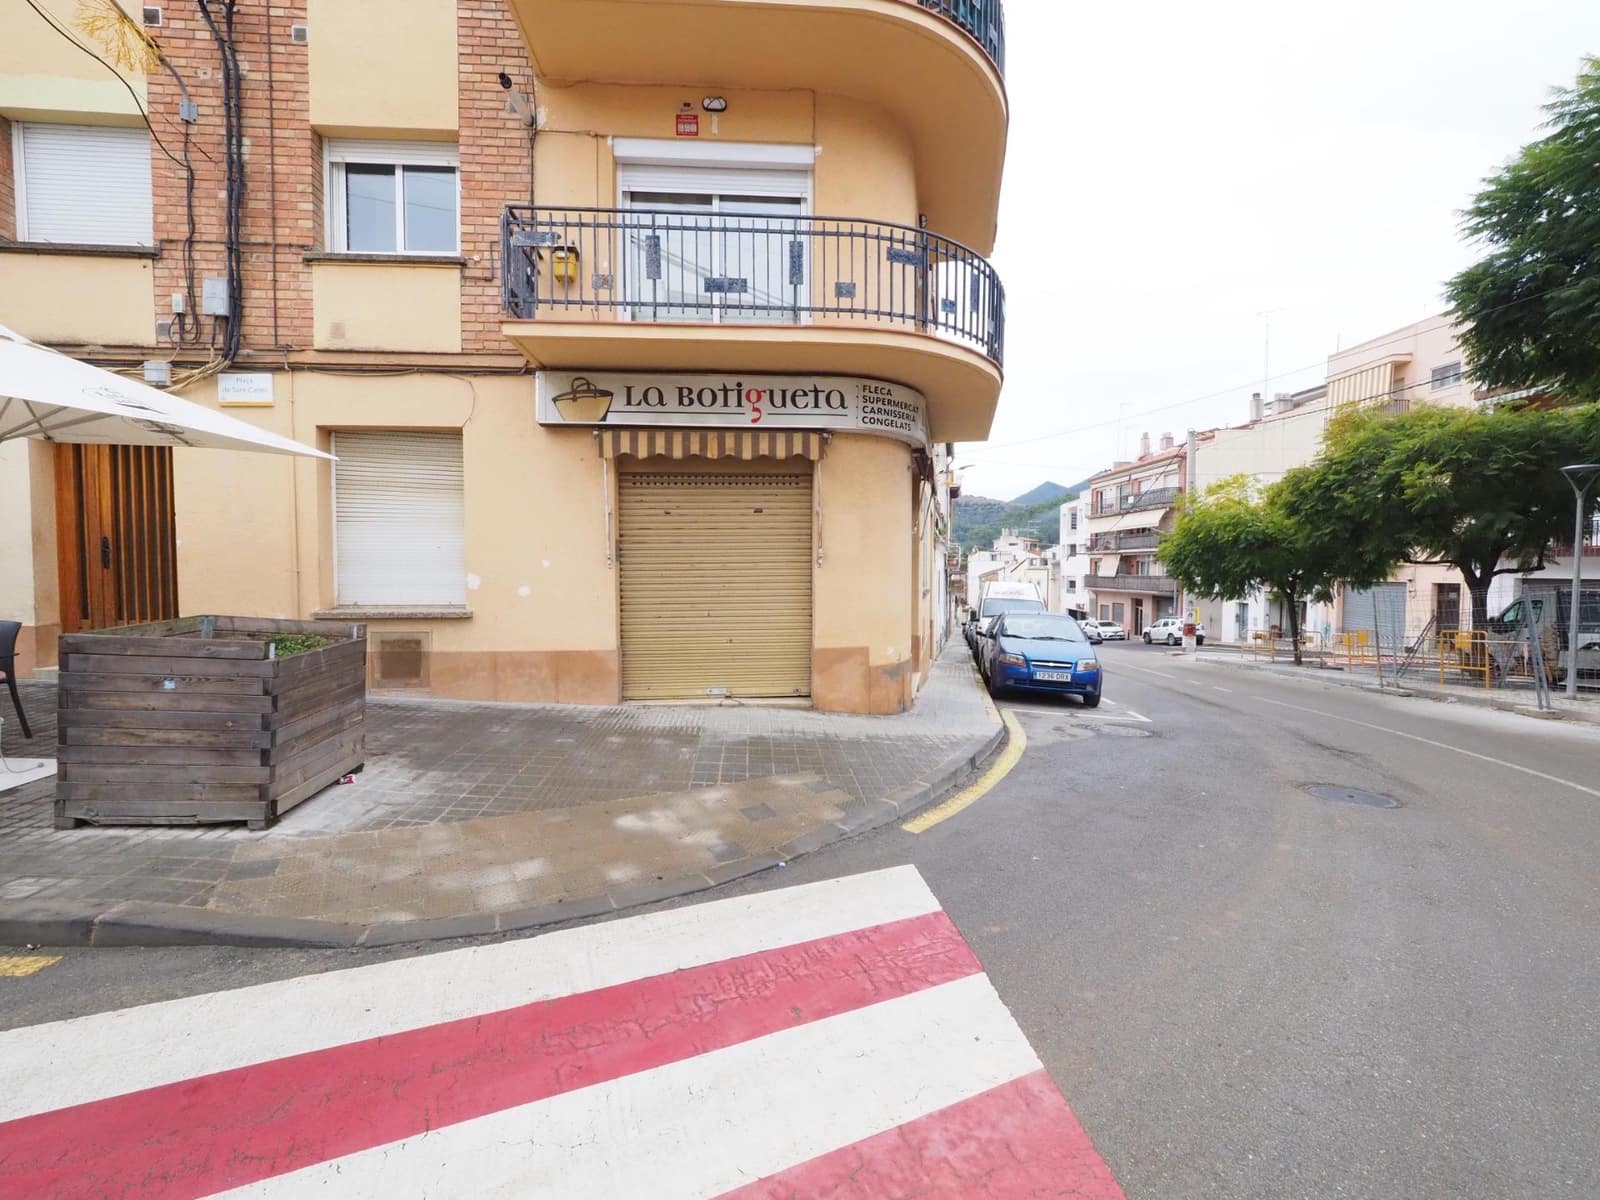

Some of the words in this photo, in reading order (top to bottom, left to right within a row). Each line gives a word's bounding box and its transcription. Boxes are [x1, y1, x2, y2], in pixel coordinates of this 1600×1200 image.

[862, 384, 893, 396] FLECA
[675, 382, 848, 423] Botigueta
[862, 395, 919, 413] SUPERMERCAT
[862, 405, 916, 422] CARNISSERIA
[862, 416, 912, 431] CONGELATS
